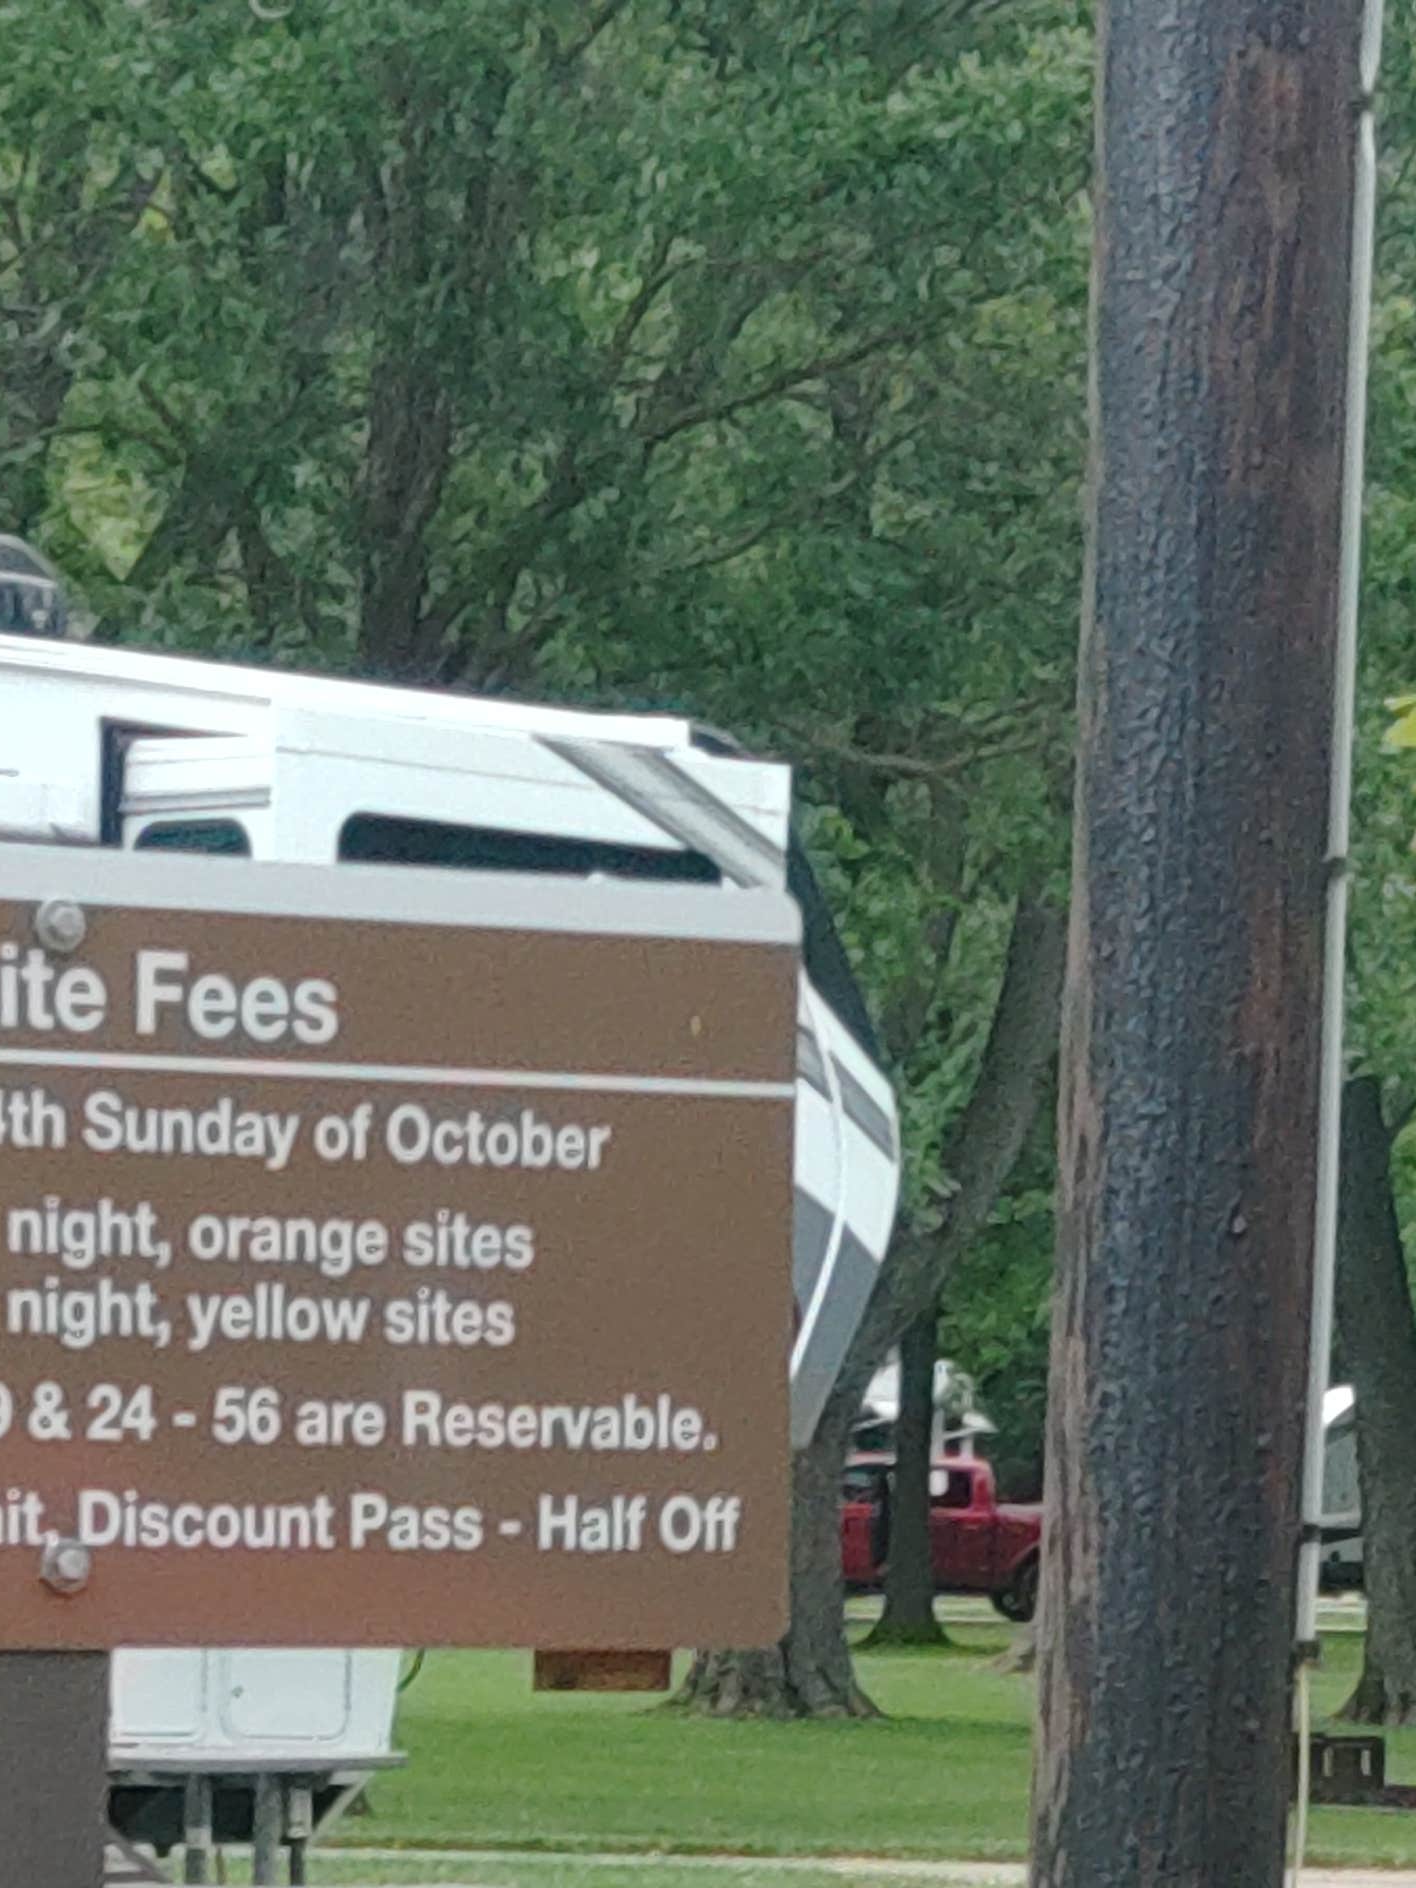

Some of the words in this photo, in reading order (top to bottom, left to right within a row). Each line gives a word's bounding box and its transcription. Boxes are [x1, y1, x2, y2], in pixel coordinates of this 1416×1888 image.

[137, 951, 339, 1044] Fees
[83, 1091, 299, 1170] Sunday
[315, 1103, 373, 1161] of
[387, 1104, 612, 1170] October
[8, 1196, 171, 1268] night,
[188, 1215, 388, 1277] orange
[402, 1209, 535, 1270] sites
[8, 1276, 171, 1349] night,
[188, 1283, 370, 1351] yellow
[384, 1287, 516, 1346] sites
[28, 1381, 73, 1440] &
[87, 1384, 158, 1441] 24
[173, 1412, 197, 1428] -
[213, 1386, 282, 1445] 56
[295, 1401, 386, 1446] are
[403, 1390, 718, 1452] Reservable.
[77, 1490, 335, 1550] Discount
[350, 1493, 484, 1551] Pass
[500, 1520, 522, 1536] -
[538, 1494, 647, 1552] Half
[659, 1495, 742, 1553] Off
